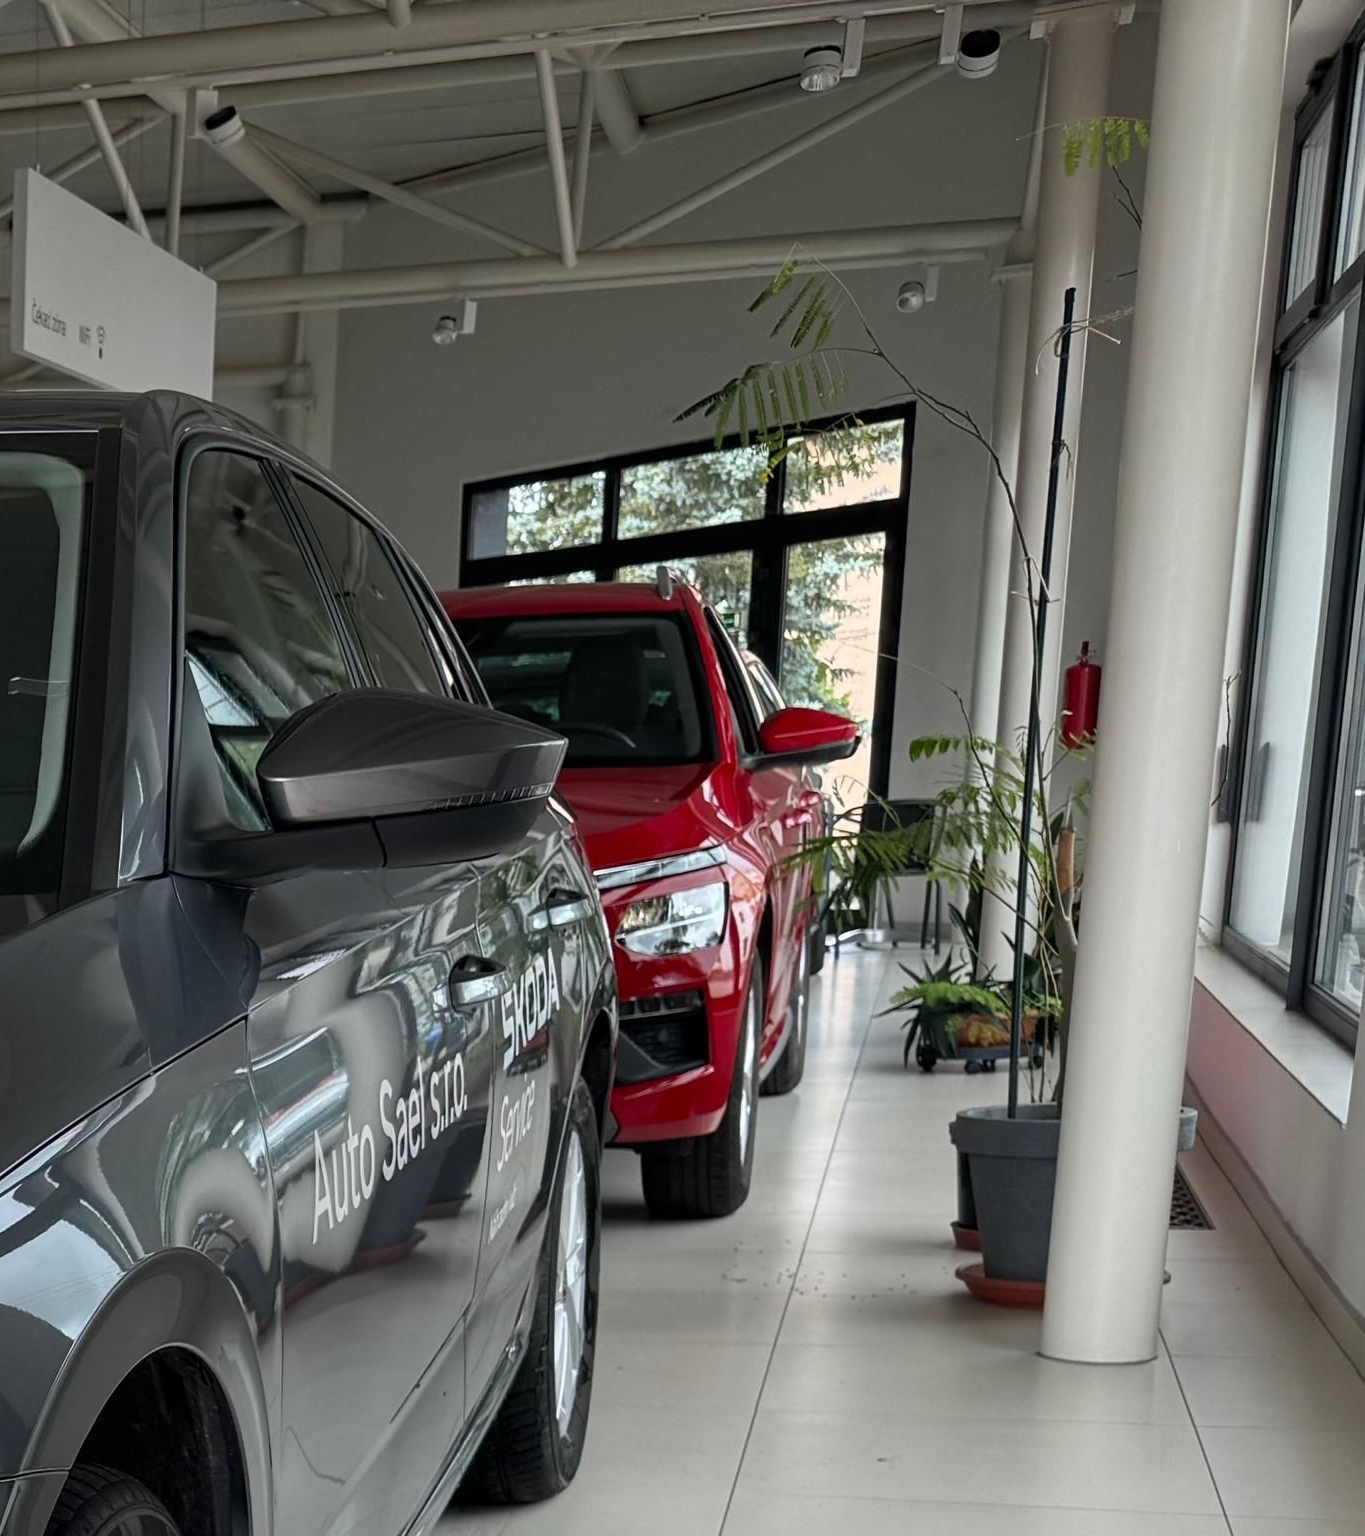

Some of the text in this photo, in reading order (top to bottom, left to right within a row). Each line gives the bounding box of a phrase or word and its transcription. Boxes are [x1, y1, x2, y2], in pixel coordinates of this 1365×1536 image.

[312, 1115, 374, 1246] Auto
[380, 1055, 425, 1182] Sael
[430, 1052, 468, 1141] s.r.o.
[497, 1072, 535, 1172] Service
